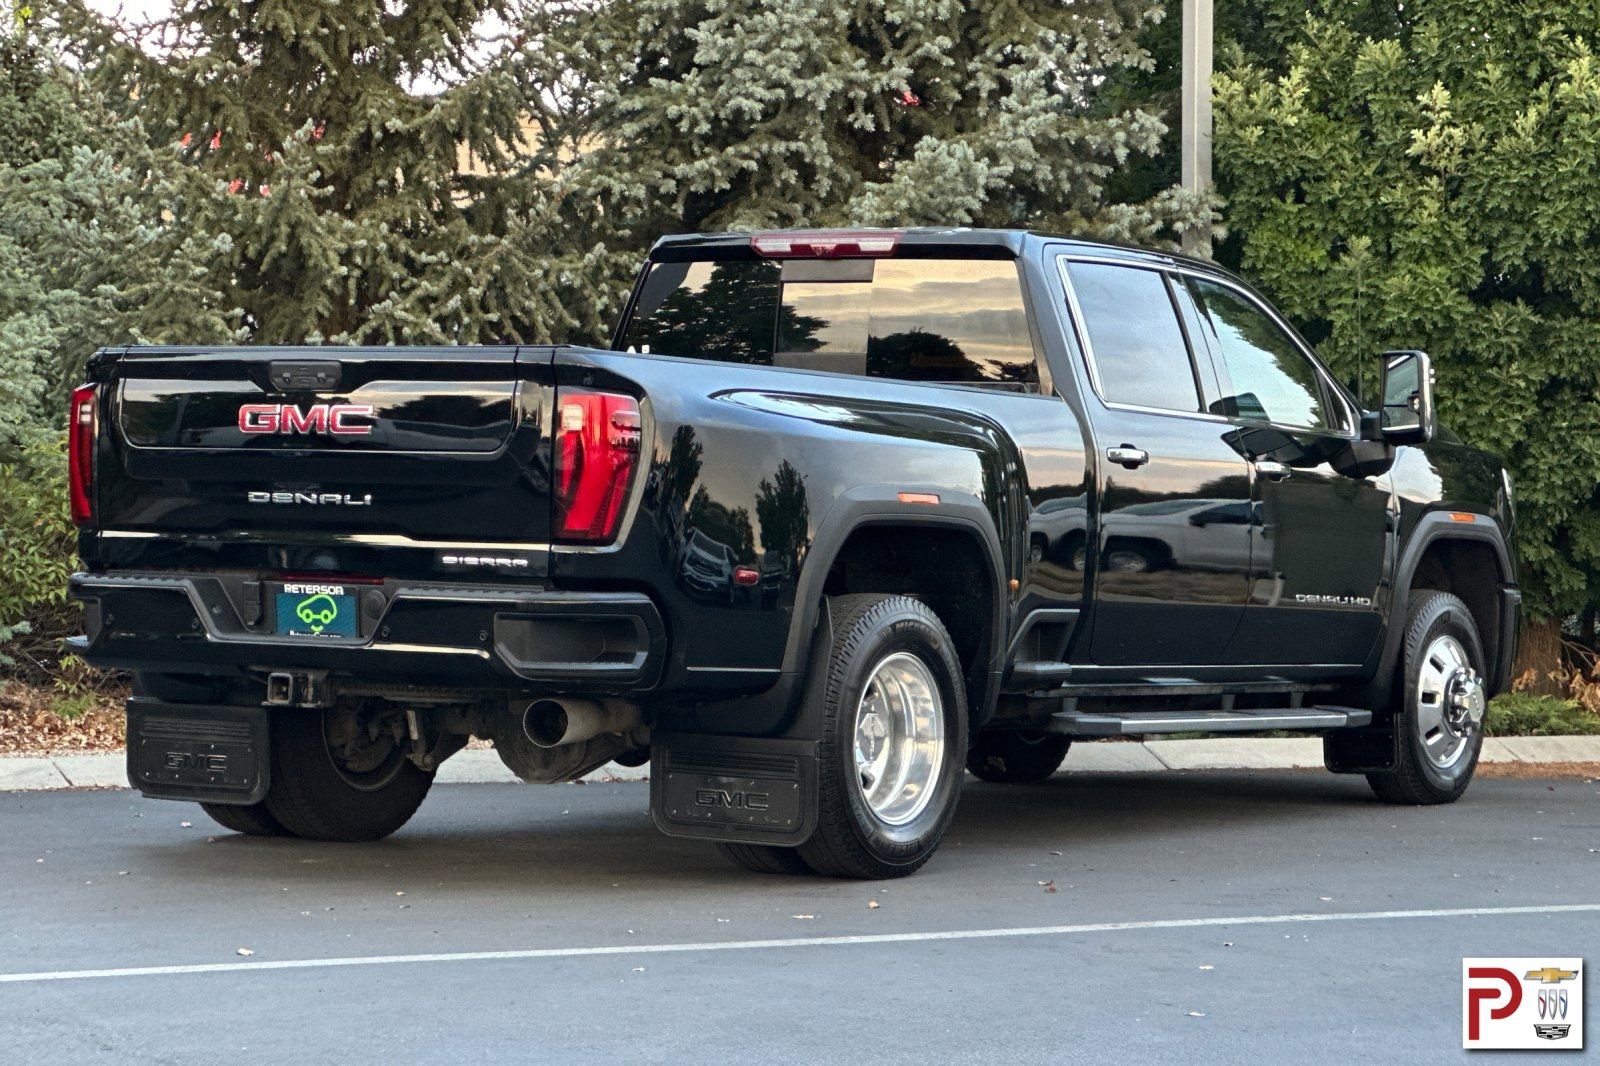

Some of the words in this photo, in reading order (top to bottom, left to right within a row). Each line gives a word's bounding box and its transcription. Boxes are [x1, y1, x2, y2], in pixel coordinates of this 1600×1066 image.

[238, 403, 374, 435] GMC
[248, 491, 372, 505] DENALI
[442, 556, 528, 567] SIERRA
[1295, 594, 1348, 604] DENALI
[164, 751, 227, 773] GMC
[695, 789, 769, 811] GMC
